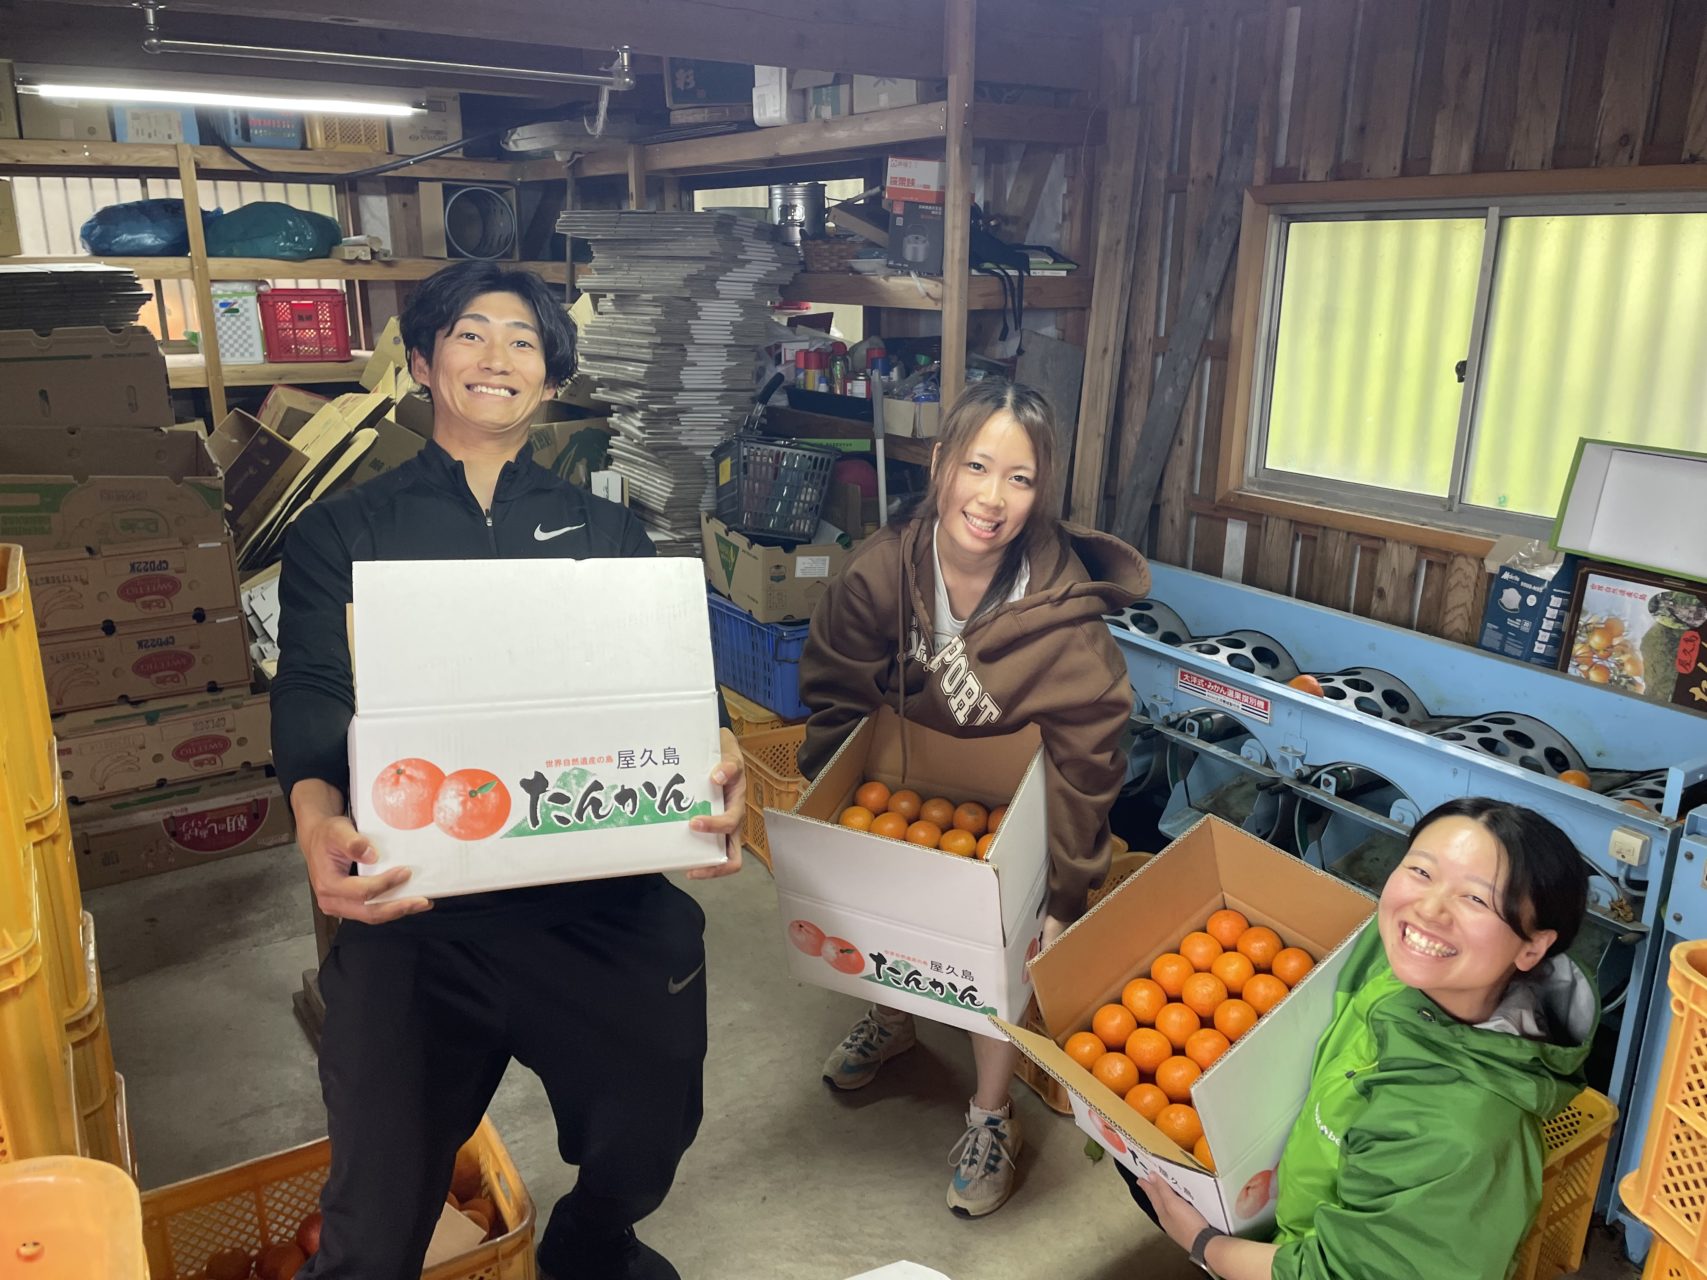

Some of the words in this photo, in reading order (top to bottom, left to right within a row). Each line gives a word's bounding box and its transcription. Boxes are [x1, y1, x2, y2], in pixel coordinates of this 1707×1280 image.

[545, 753, 614, 769] 世界自然遺産の島
[617, 746, 681, 770] 屋久島
[520, 771, 694, 828] たんかん
[869, 952, 985, 1007] たんかん
[930, 960, 975, 982] 屋久島
